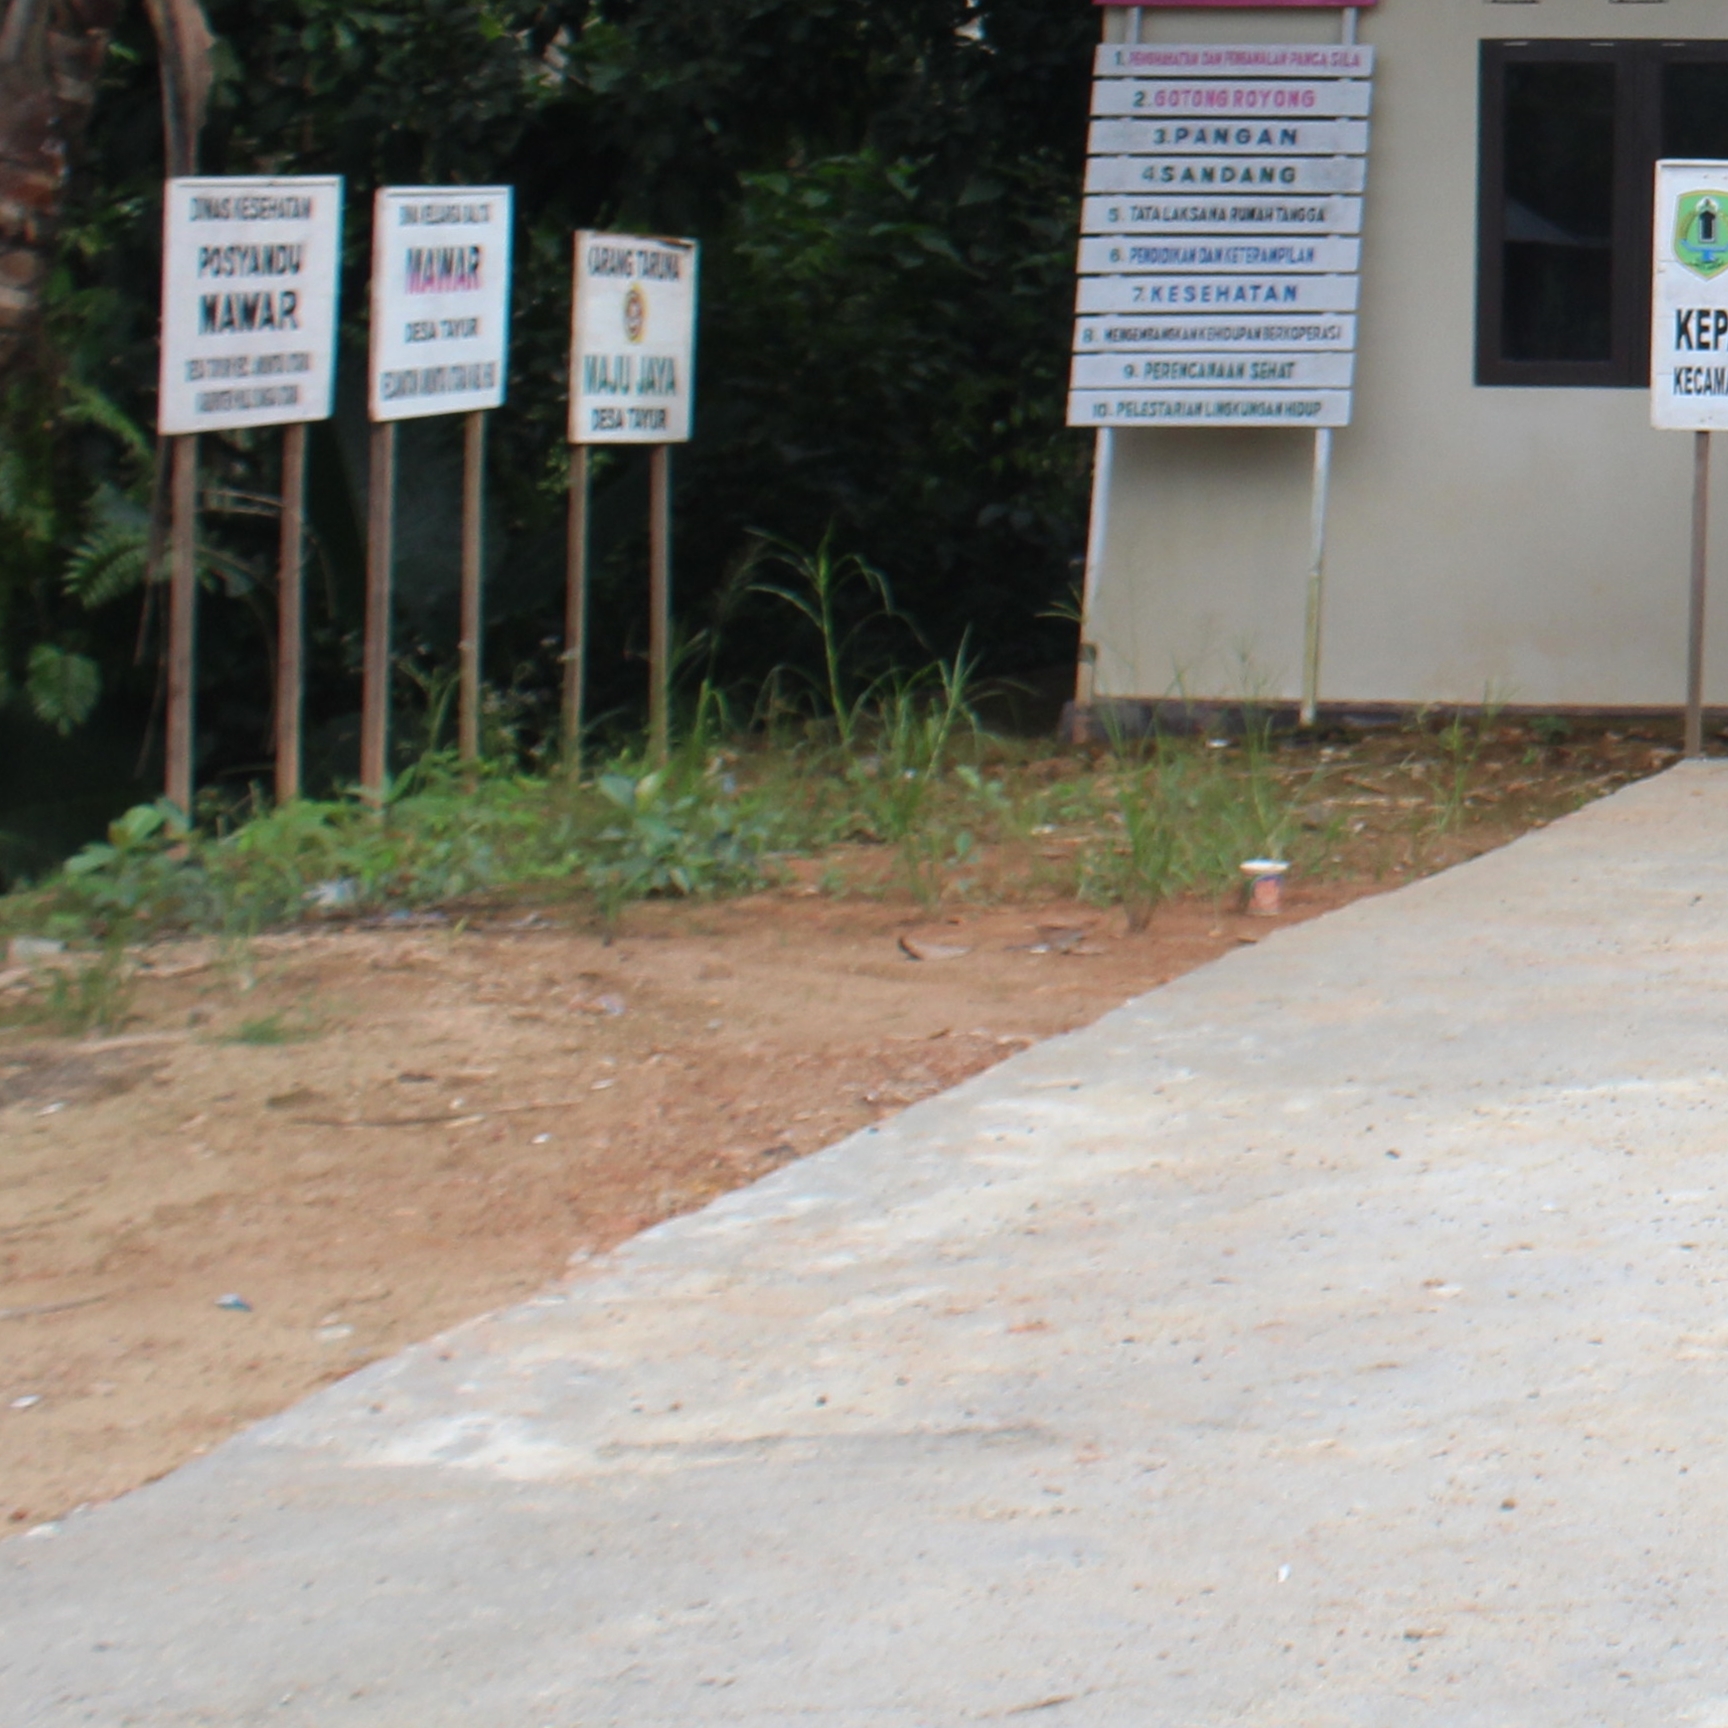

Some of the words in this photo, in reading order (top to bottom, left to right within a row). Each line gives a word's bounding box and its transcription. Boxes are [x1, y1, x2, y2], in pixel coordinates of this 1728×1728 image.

[1233, 90, 1316, 108] ROYONG
[1229, 206, 1274, 221] RUMAH
[1275, 206, 1325, 222] TANGGA
[199, 244, 304, 278] POSYANDU
[1129, 247, 1197, 263] PENDIDIKAN
[1199, 247, 1222, 263] DAN
[1224, 246, 1315, 264] KETERAMPILAN
[405, 244, 482, 294] MAWAR
[199, 290, 300, 335] MAWAR
[405, 320, 437, 343] DESA
[440, 317, 479, 340] TAYUR
[583, 354, 631, 396] MAJU
[636, 355, 676, 396] JAYA
[1251, 362, 1297, 380] SEHAT
[591, 408, 623, 432] DESA
[627, 408, 668, 432] TAYUR
[1116, 402, 1202, 417] PELESTARIAN
[1285, 402, 1322, 418] HIDUP
